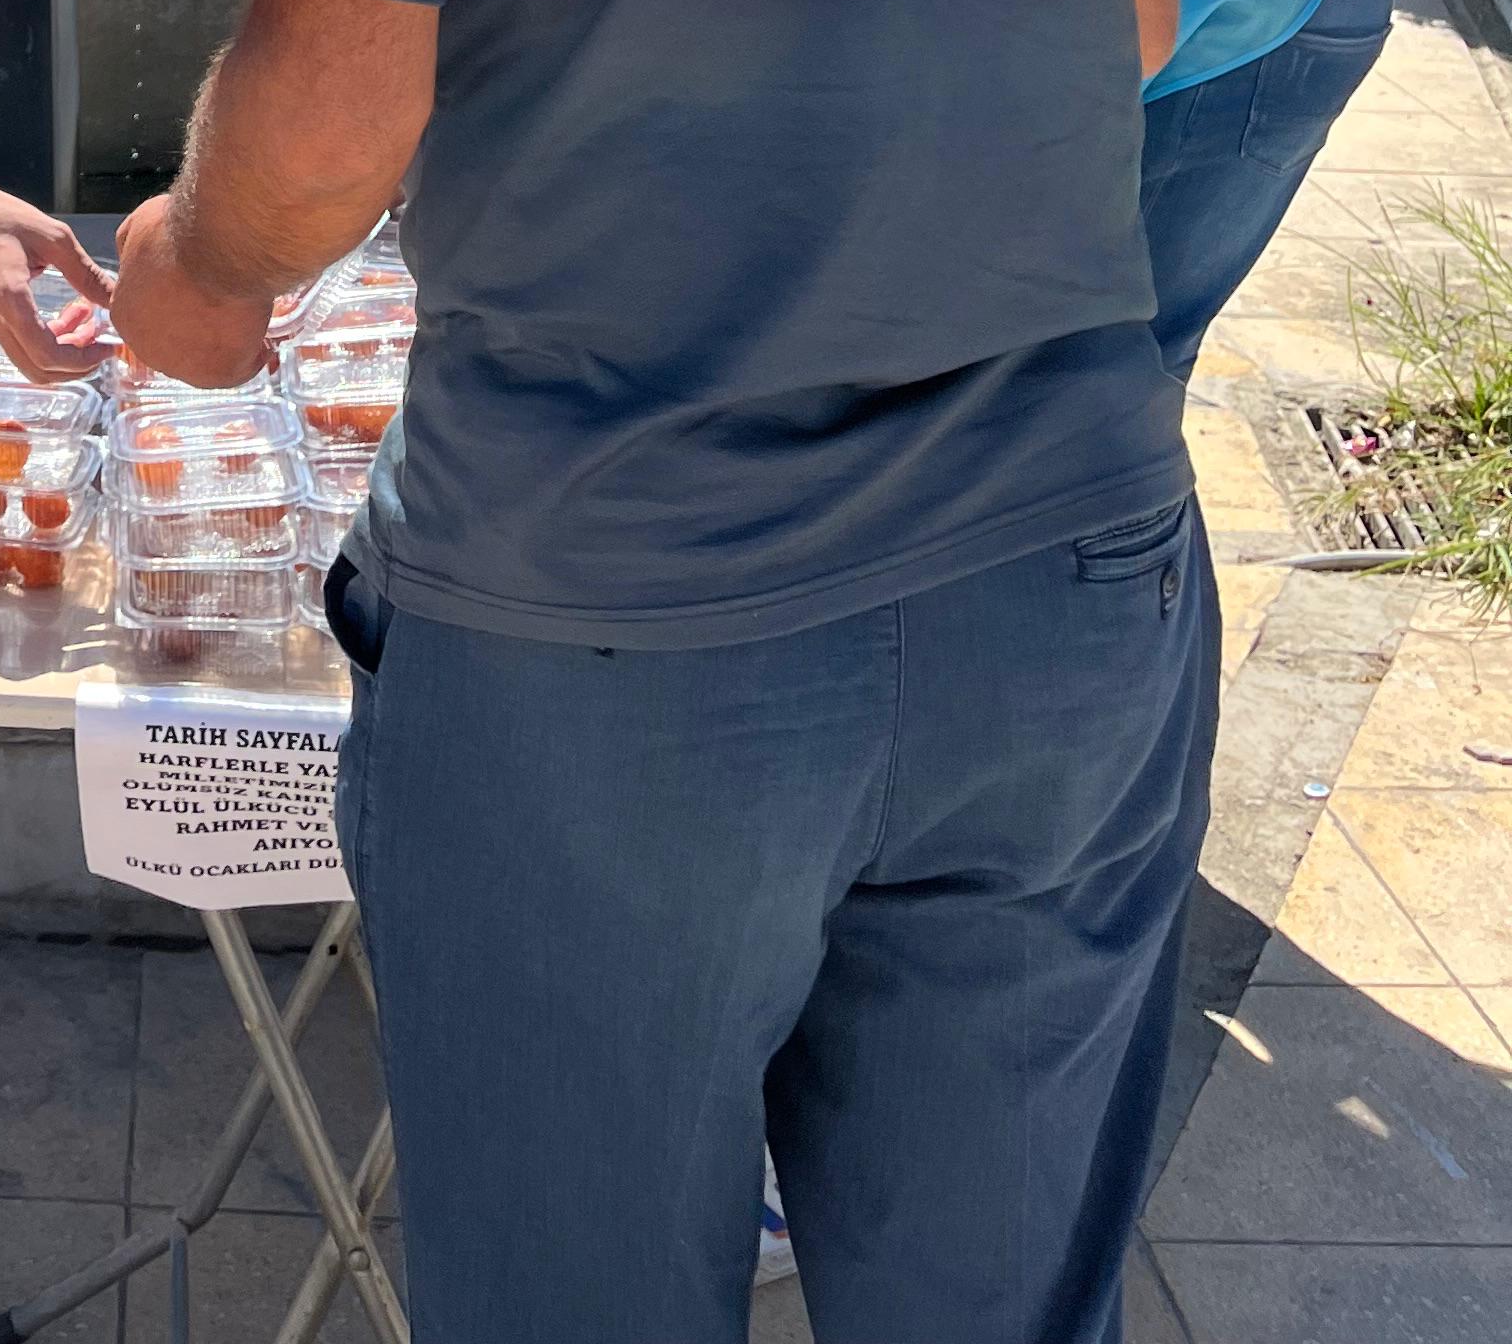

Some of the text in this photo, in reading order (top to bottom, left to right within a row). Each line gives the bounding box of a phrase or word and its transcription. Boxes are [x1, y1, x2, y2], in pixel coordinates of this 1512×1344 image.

[145, 721, 228, 747] TARİH
[138, 752, 289, 775] HARFLERLE
[125, 796, 205, 814] EYLÜL
[175, 819, 329, 835] RAHMET VE
[253, 837, 340, 852] ANIYO
[189, 858, 302, 877] OCAKLARI
[308, 856, 344, 870] DÜ
